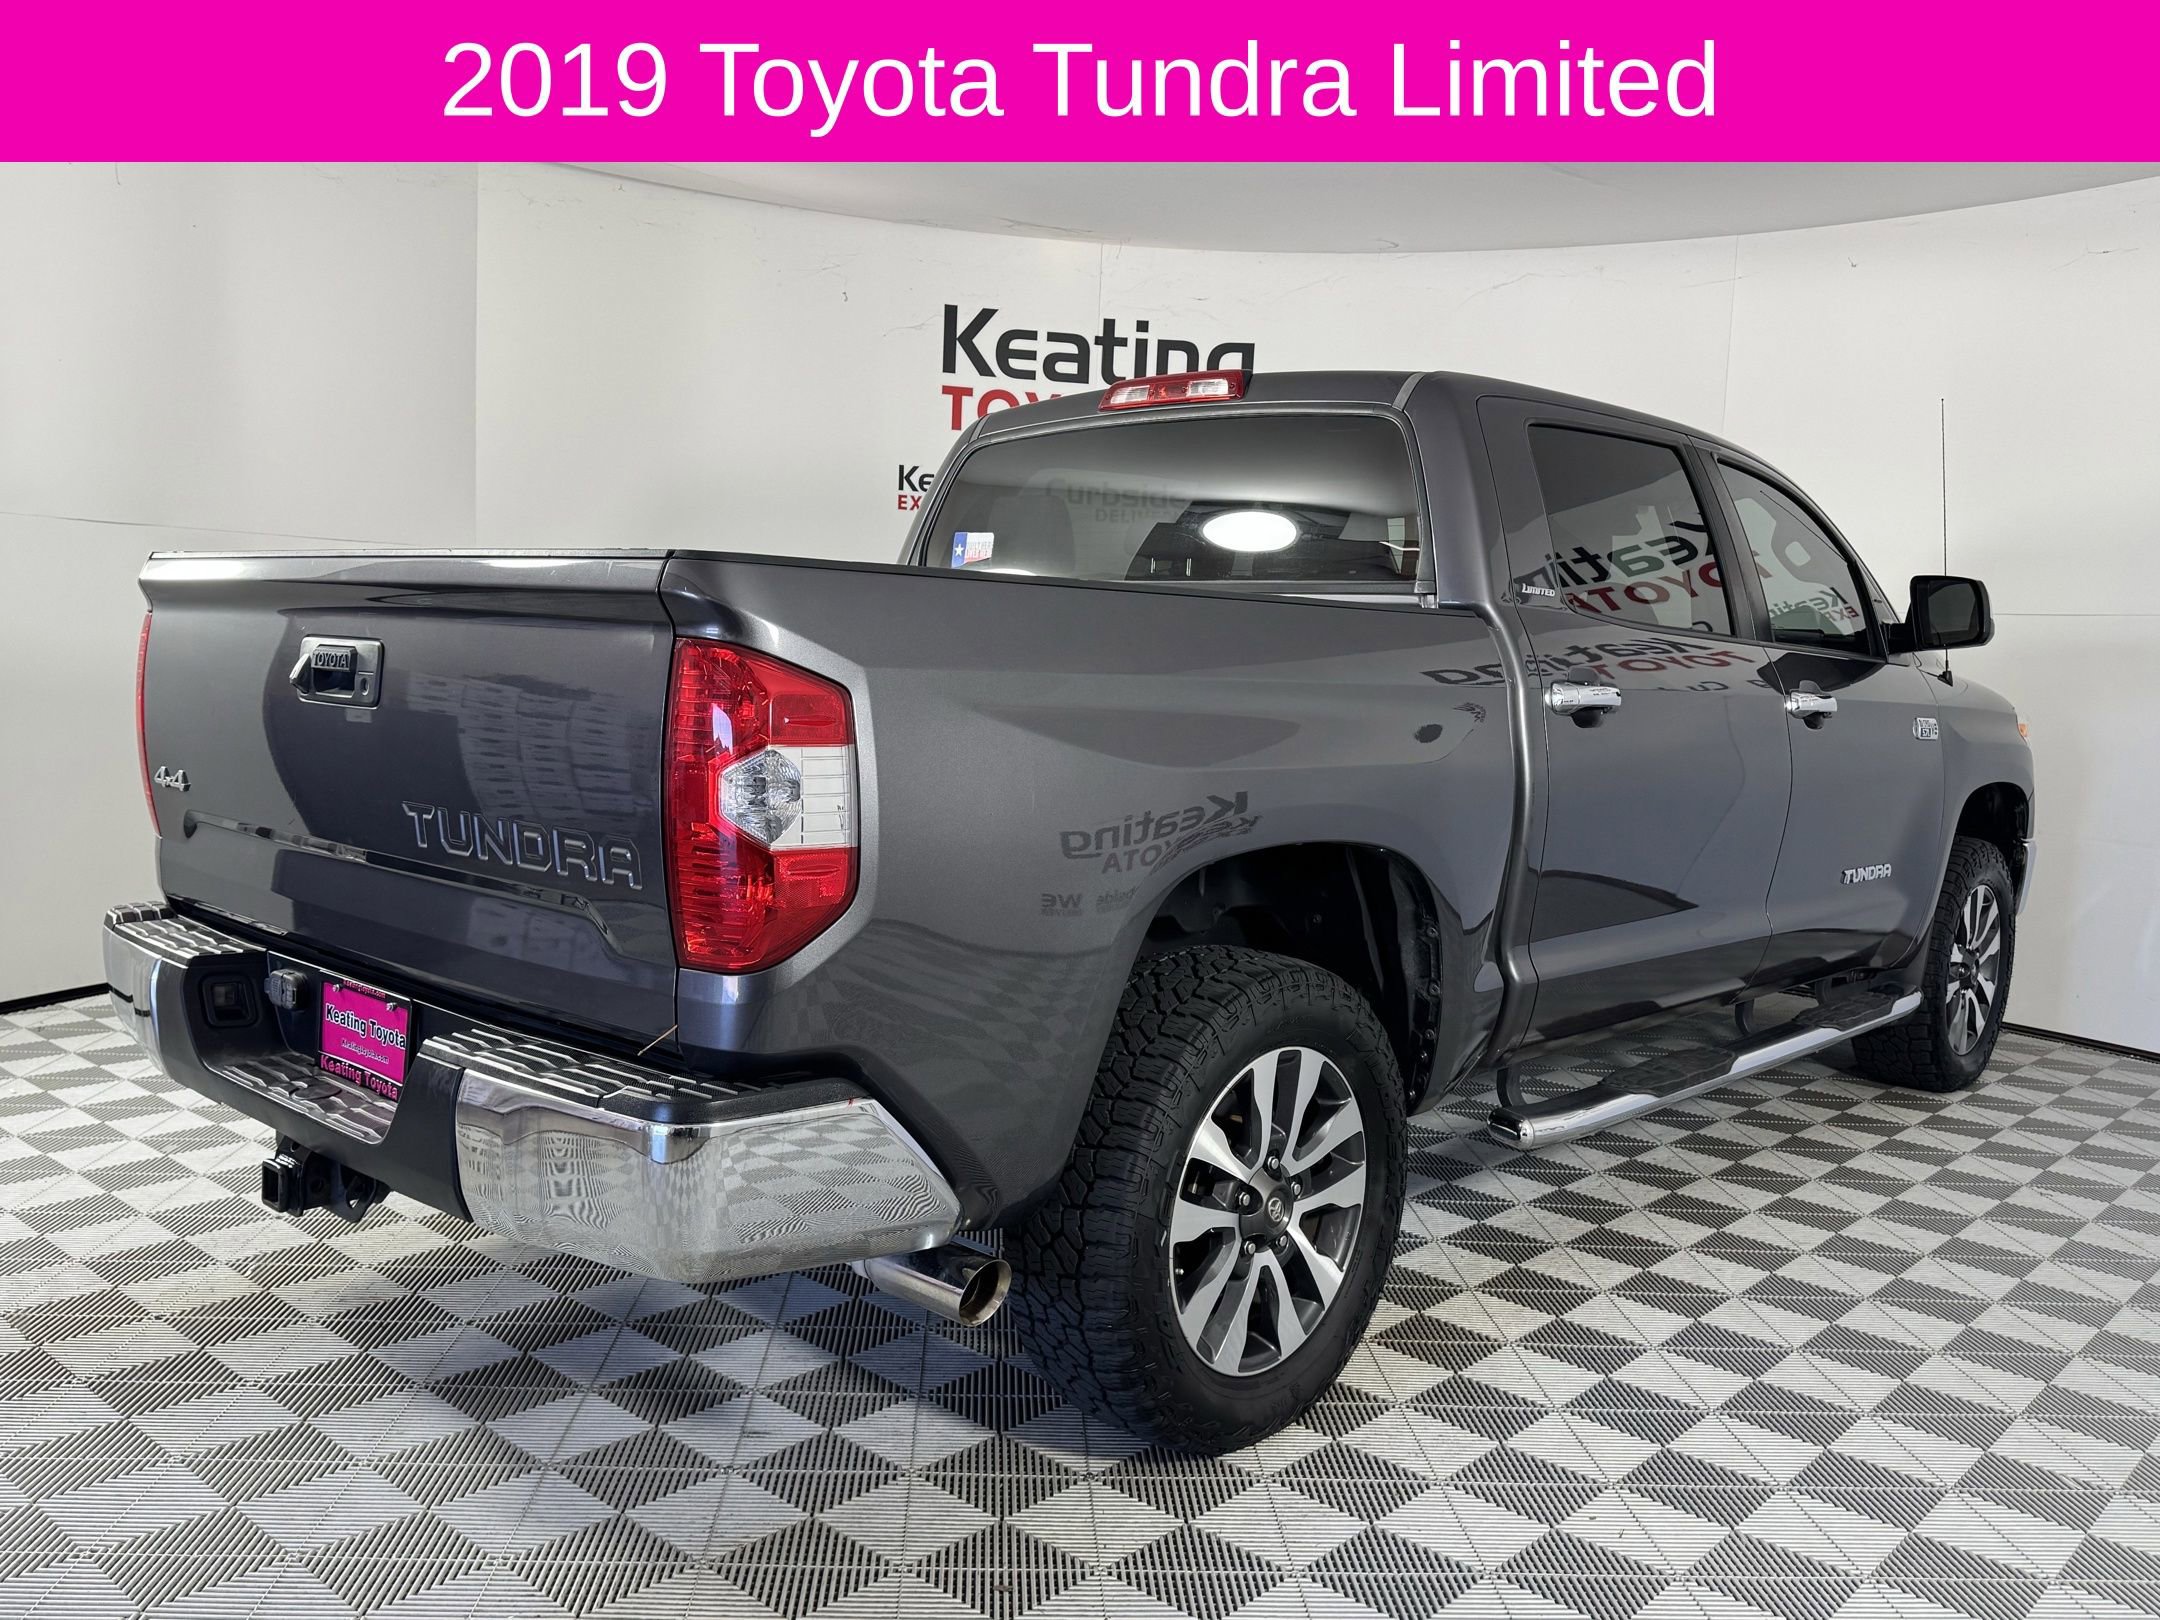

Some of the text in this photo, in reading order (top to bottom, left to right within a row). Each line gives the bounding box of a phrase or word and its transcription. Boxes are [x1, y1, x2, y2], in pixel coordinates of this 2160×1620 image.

[1521, 583, 1556, 597] LIMITED
[313, 651, 349, 669] TOYOTA
[401, 800, 643, 890] TUNDRA
[1841, 863, 1892, 885] TUNDRA
[325, 1003, 407, 1050] Keating Toyota
[320, 1054, 398, 1101] Keating Toyota
